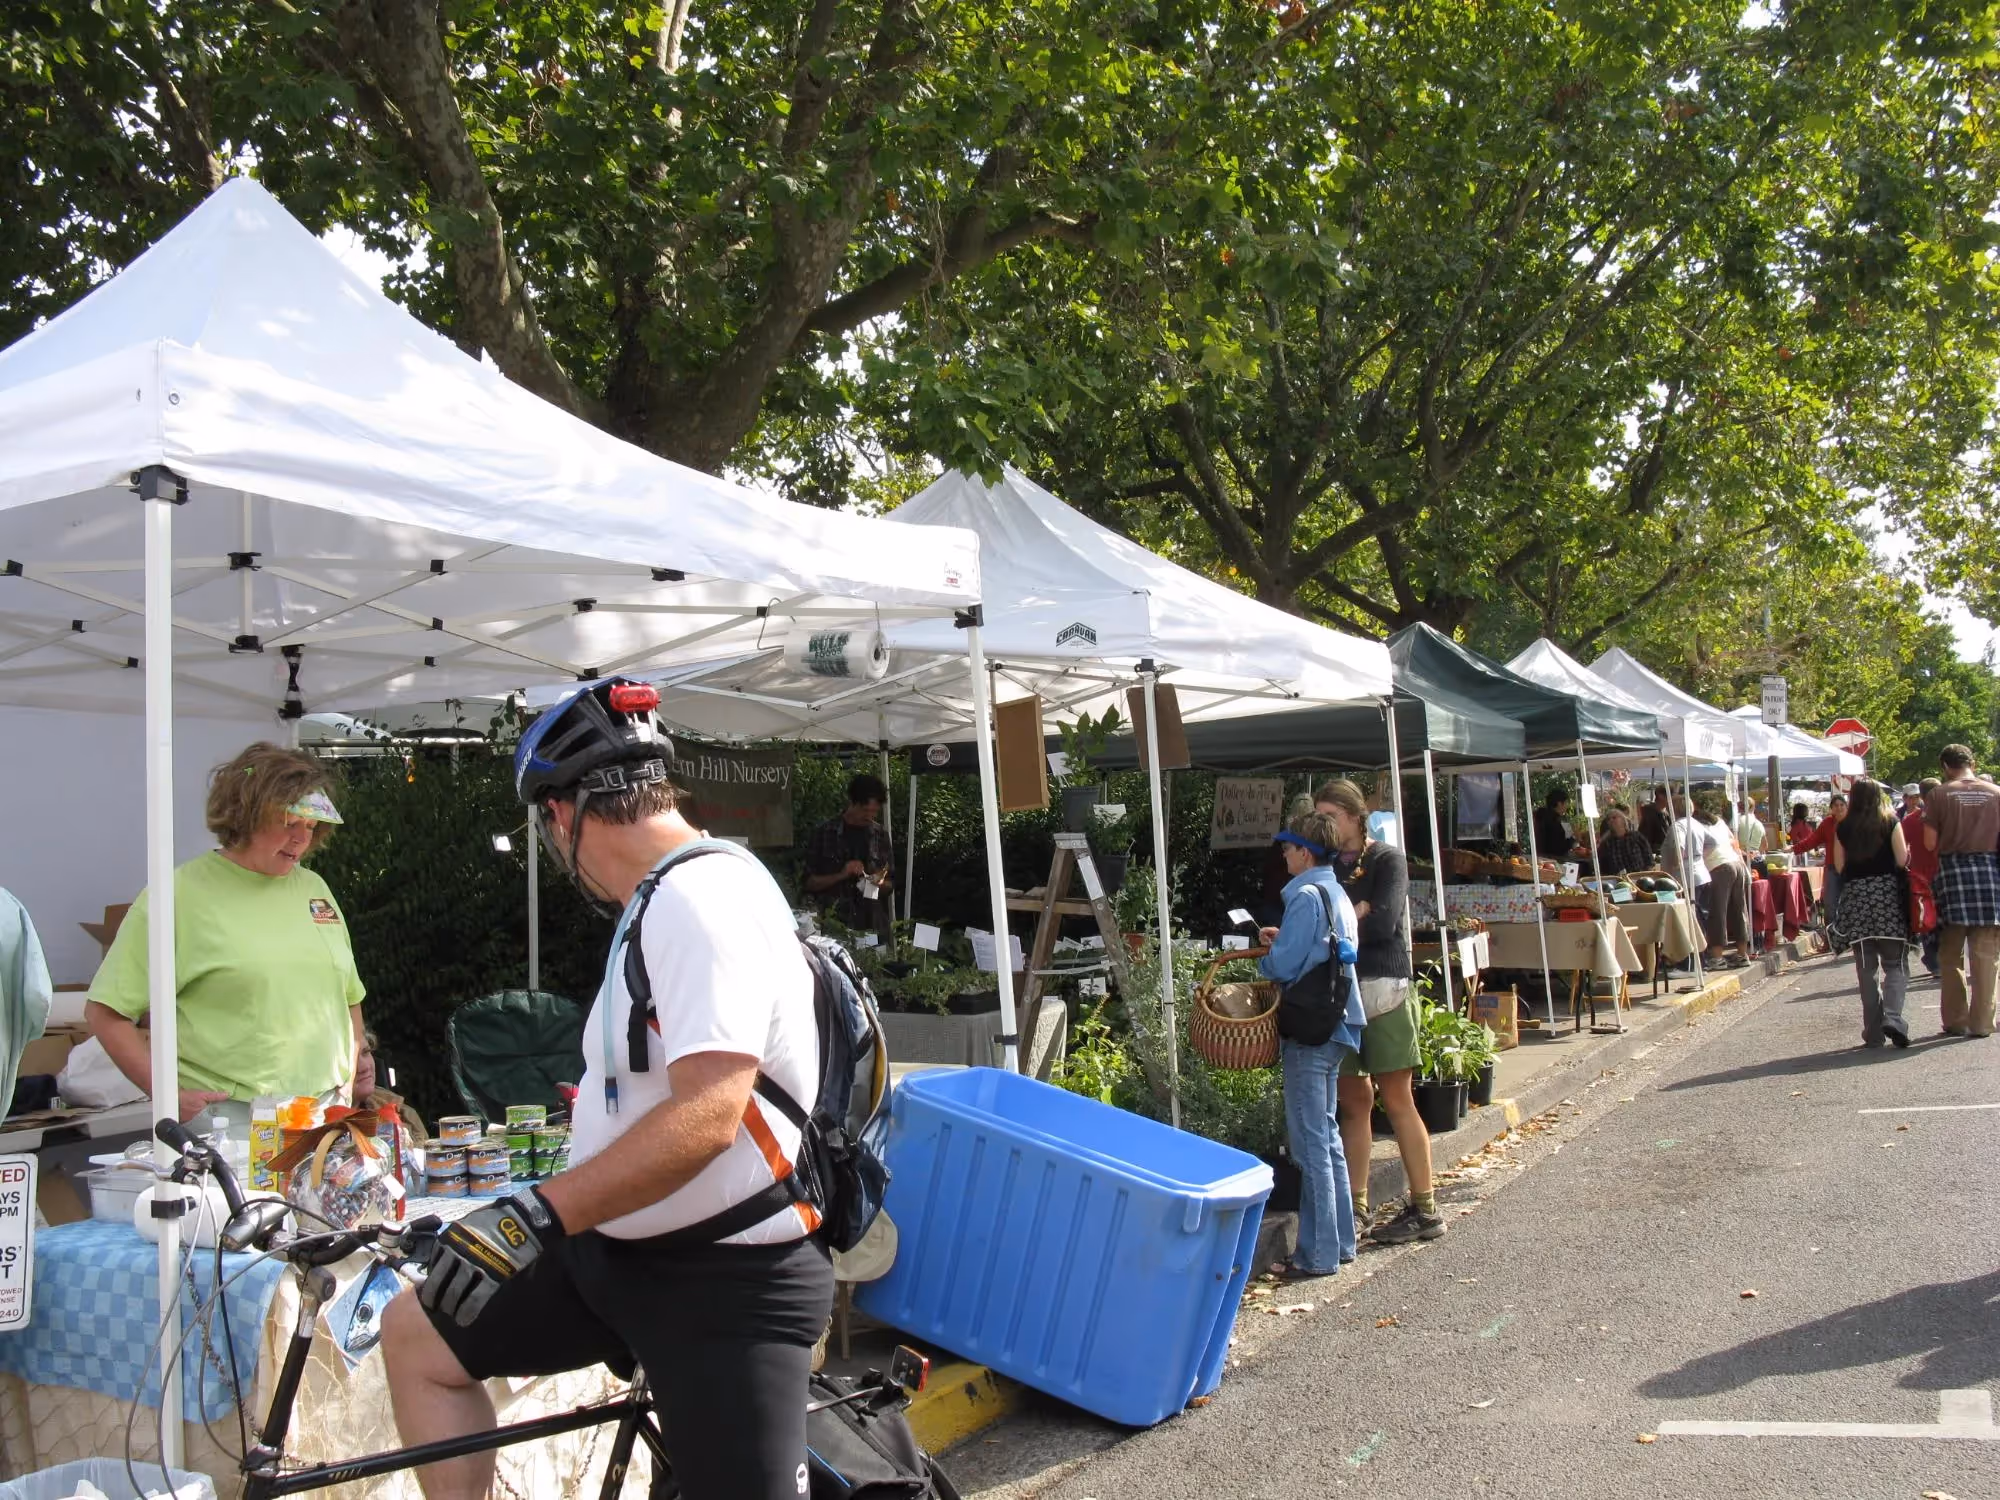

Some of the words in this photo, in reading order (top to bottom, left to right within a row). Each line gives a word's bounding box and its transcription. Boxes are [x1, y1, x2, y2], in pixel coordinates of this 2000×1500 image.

[1056, 625, 1096, 643] CARAVAN
[672, 757, 695, 778] ern
[700, 755, 729, 783] Hill
[732, 760, 792, 790] Nursery
[0, 1168, 26, 1183] ED
[0, 1191, 21, 1205] YS
